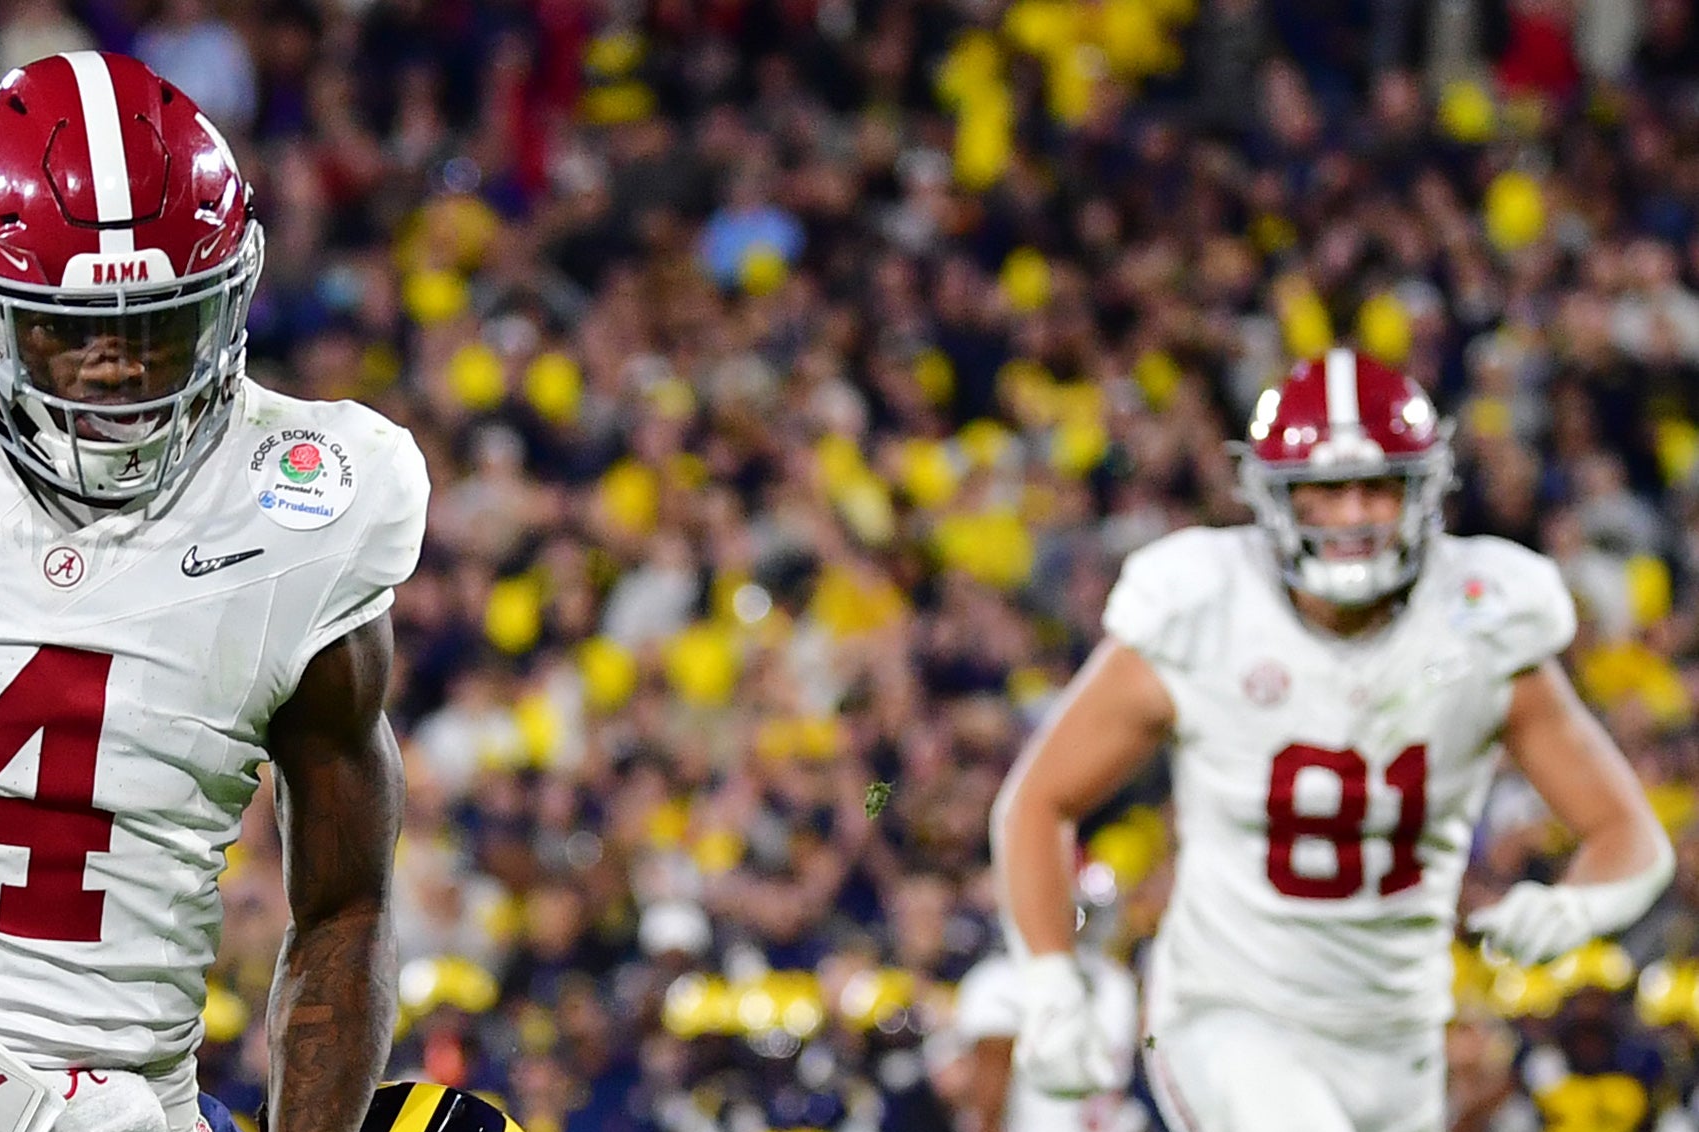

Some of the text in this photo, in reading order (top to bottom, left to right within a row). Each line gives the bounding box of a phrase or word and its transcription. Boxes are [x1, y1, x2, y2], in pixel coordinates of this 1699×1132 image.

[92, 260, 149, 284] BAMA
[250, 429, 353, 488] ROSE BOWL GAME
[275, 483, 324, 498] presented by
[278, 499, 334, 517] Prudential
[48, 552, 76, 580] A
[1265, 742, 1429, 899] 81
